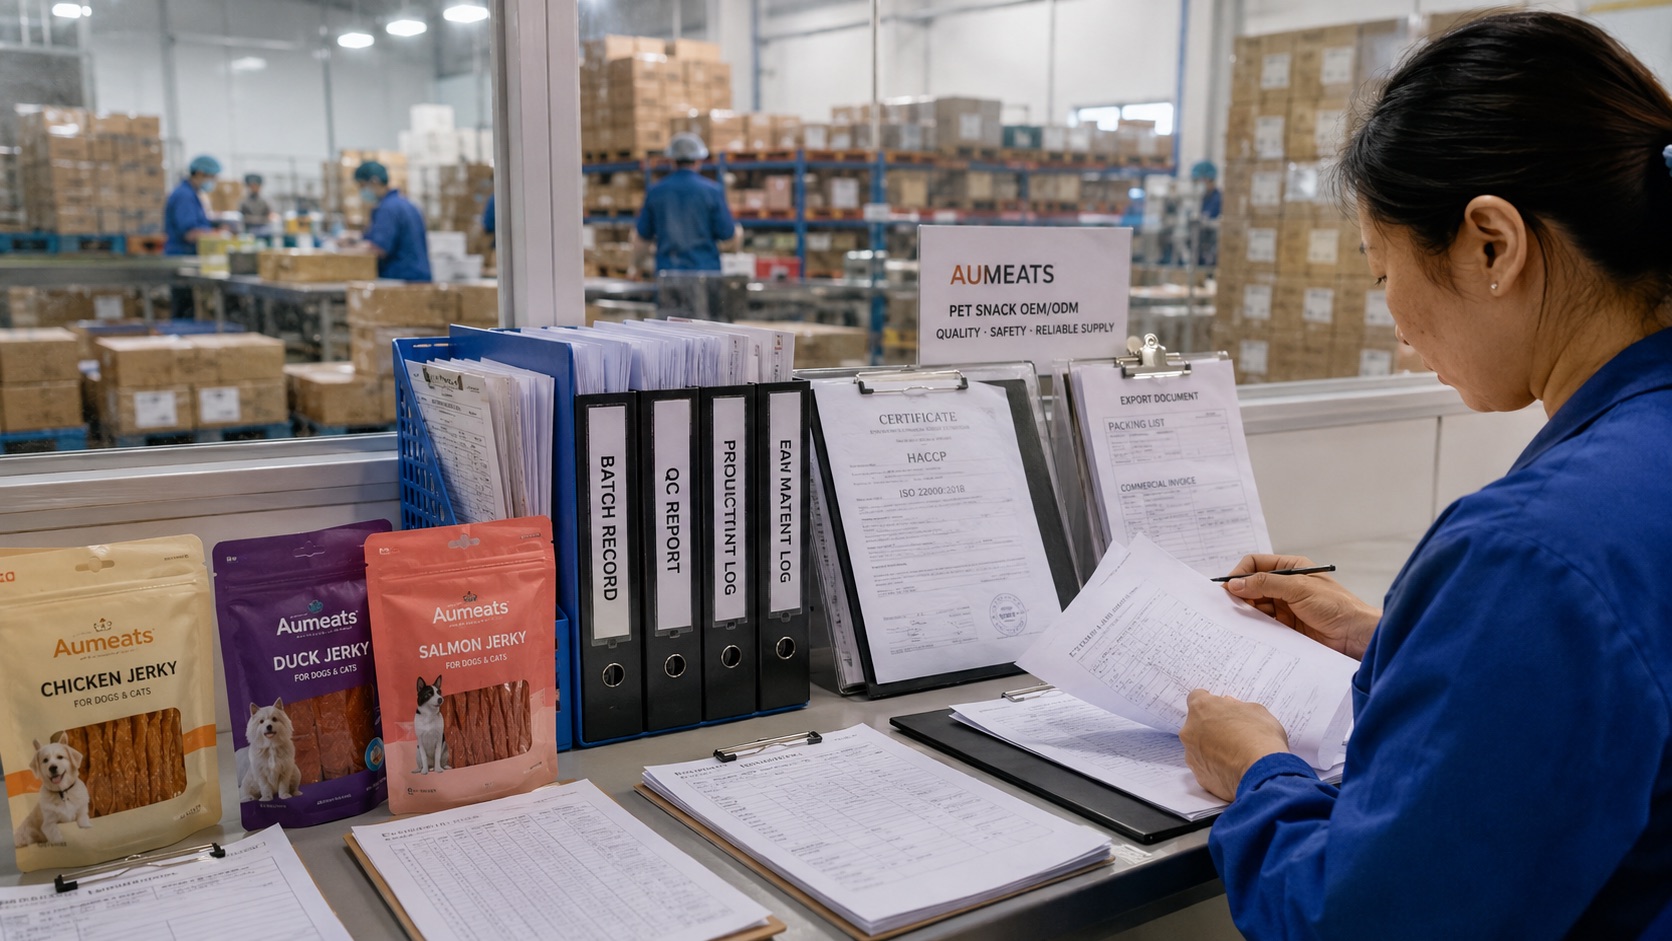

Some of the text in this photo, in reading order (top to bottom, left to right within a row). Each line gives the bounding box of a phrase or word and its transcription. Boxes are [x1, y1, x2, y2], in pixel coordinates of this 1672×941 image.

[950, 264, 1054, 285] AUMEATS
[949, 302, 1079, 318] PET SNACK OEM/ODM
[936, 322, 1115, 340] QUALITY SAFETY RELIABLE SUPPLY
[1120, 391, 1199, 406] EXPORT DOCUMENT
[878, 411, 958, 425] CERTIFICATE
[1108, 418, 1165, 431] PACKING LIST
[906, 451, 947, 464] HACCP
[899, 488, 916, 498] ISO
[1120, 476, 1197, 493] COMMERCIAL INVOICE
[664, 467, 681, 574] QC REPORT
[780, 477, 792, 546] MATENT
[600, 455, 618, 601] BATCH RECORD
[779, 550, 792, 583] LOG
[724, 561, 737, 596] LOG
[432, 600, 509, 624] Aumeats
[276, 610, 358, 636] Aumeats
[53, 628, 154, 658] Aumeats
[418, 630, 527, 659] SALMON JERKY
[273, 641, 370, 671] DUCK JERKY
[445, 653, 508, 670] FOR DOGS & CATS
[41, 660, 177, 697] CHICKEN JERKY
[294, 664, 358, 683] FOR DOGS & CATS
[73, 687, 152, 708] FOR DOGS & CATS
